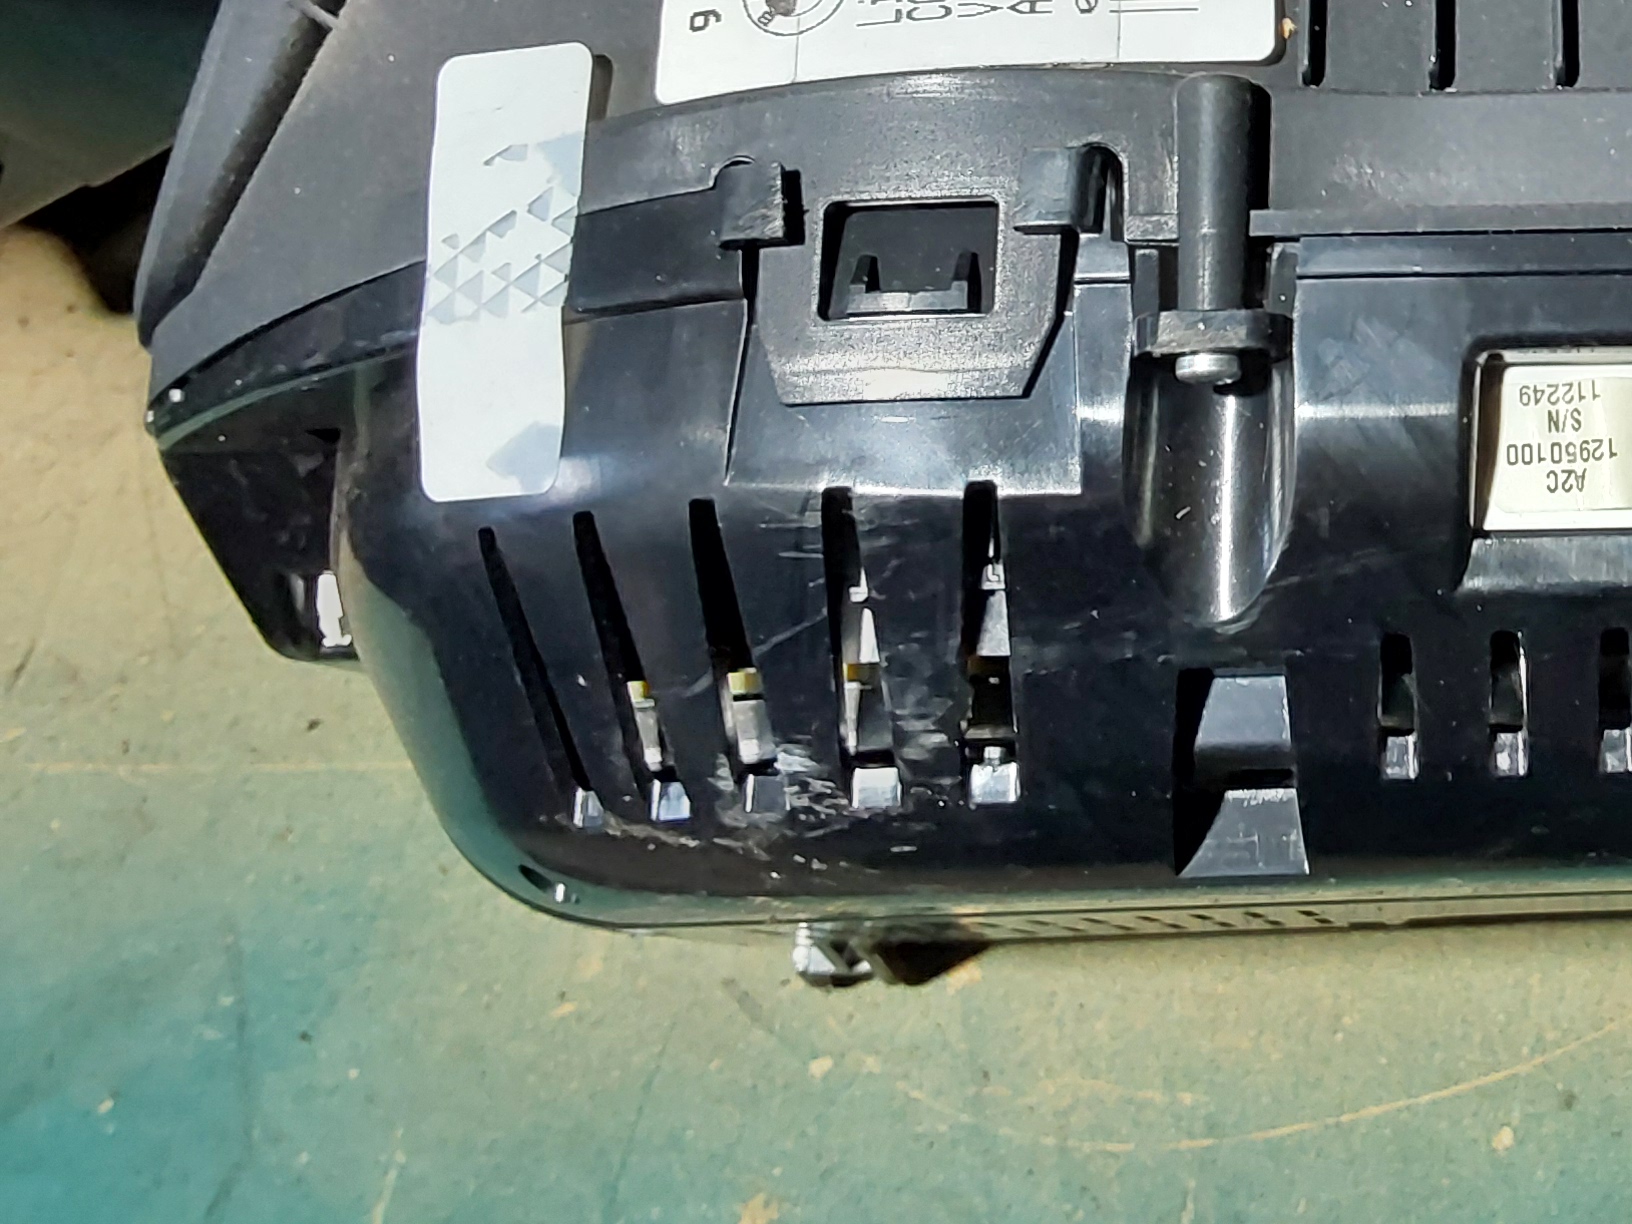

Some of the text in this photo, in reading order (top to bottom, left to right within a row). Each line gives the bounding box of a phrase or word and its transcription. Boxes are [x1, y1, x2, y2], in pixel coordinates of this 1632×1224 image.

[690, 9, 721, 32] 9
[1519, 380, 1600, 406] 112249
[1548, 408, 1582, 433] S/N
[1507, 438, 1618, 465] 12950100
[1547, 468, 1587, 493] A2C
